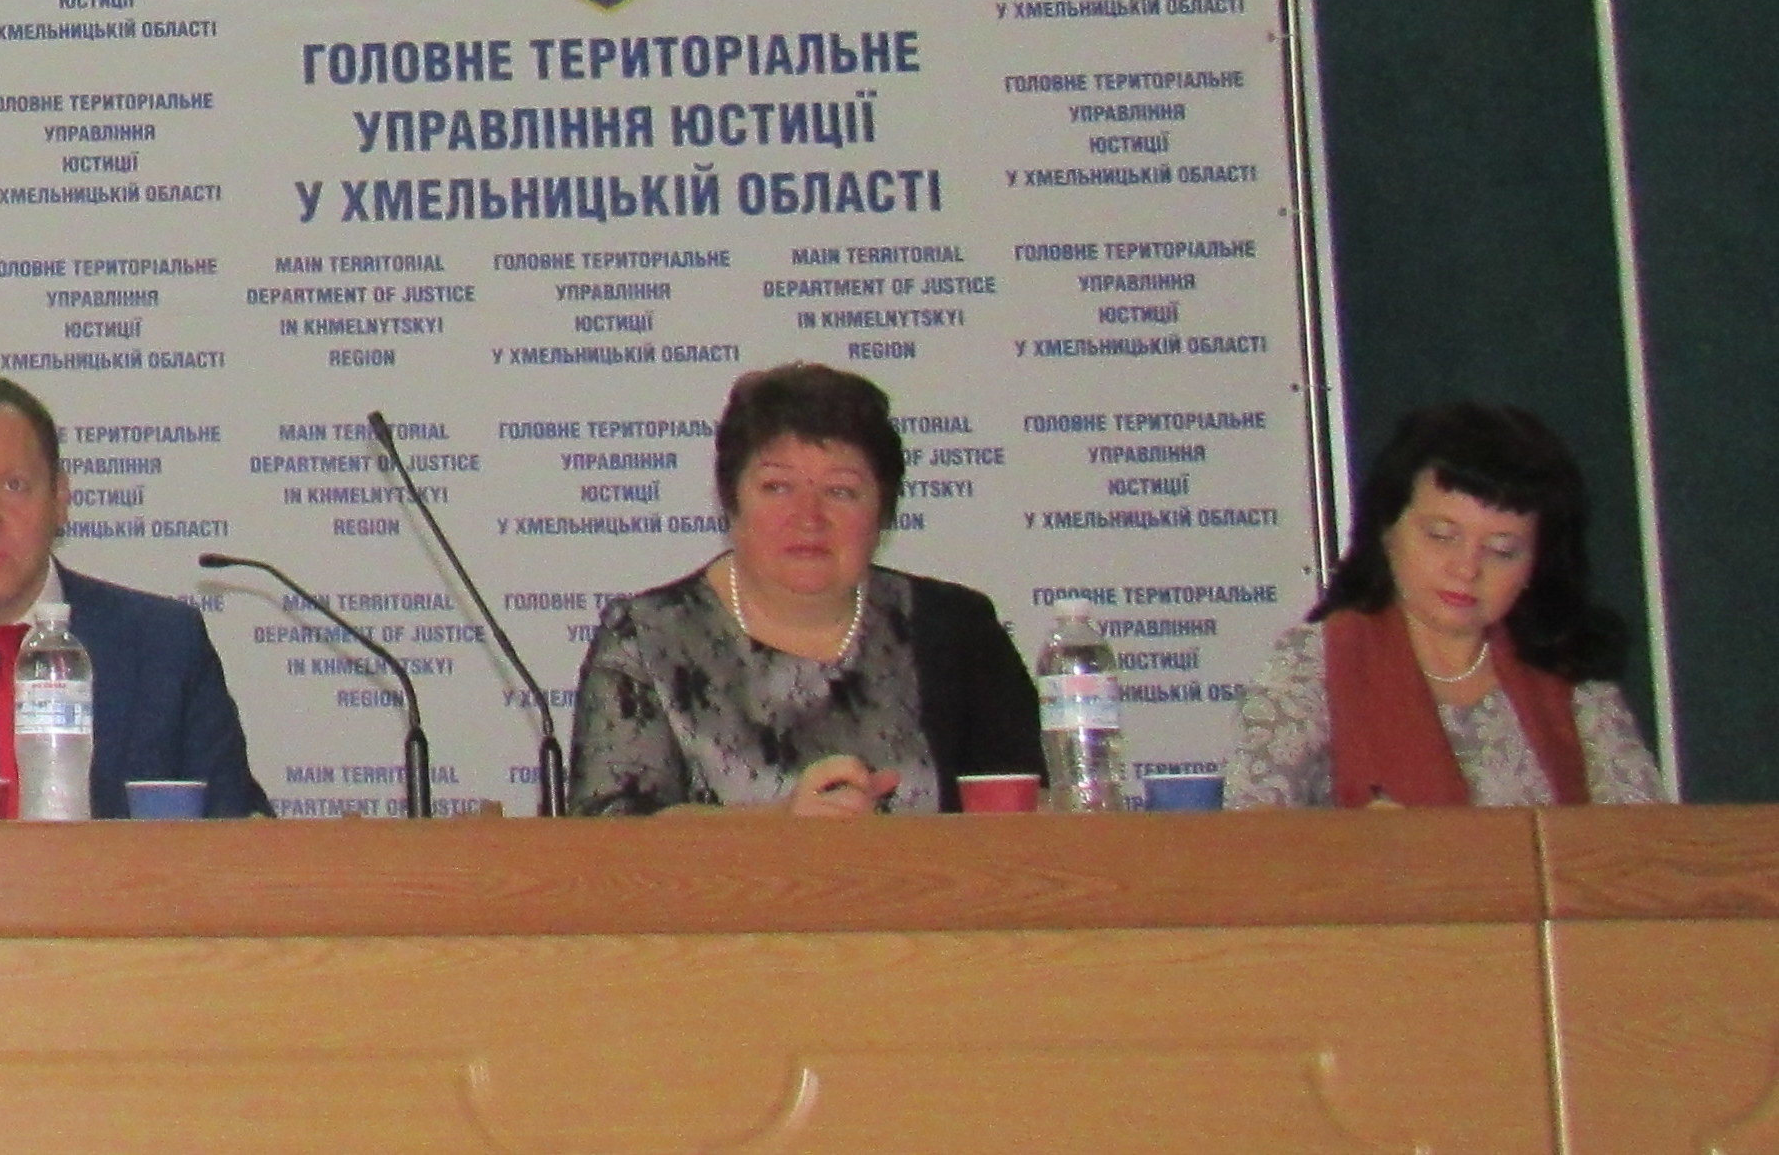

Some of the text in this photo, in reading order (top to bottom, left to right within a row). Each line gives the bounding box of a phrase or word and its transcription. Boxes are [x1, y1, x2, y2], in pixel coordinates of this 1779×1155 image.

[996, 3, 1007, 19] У
[141, 20, 217, 38] ОБЛАСТІ
[302, 30, 921, 85] ГОЛОВНЕ ТЕРИТОРІАЛЬНЕ
[1004, 71, 1245, 93] ГОЛОВНЕ ТЕРИТОРІАЛЬНЕ
[68, 92, 213, 111] ТЕРИТОРІАЛЬНЕ
[352, 90, 876, 154] УПРАВЛІННЯ ЮСТИЦІЇ
[1068, 104, 1186, 123] УПРАВЛІННЯ
[44, 124, 155, 142] УПРАВЛІННЯ
[1089, 131, 1169, 154] ЮСТИЦІЇ
[63, 150, 138, 173] ЮСТИЦІЇ
[1005, 163, 1258, 187] У ХМЕЛЬНИЦЬКІЙ ОБЛАСТІ
[144, 184, 221, 202] ОБЛАСТІ
[293, 163, 942, 224] У ХМЕЛЬНИЦЬКІЙ ОБЛАСТІ
[493, 250, 730, 271] ГОЛОВНЕ ТЕРИТОРІАЛЬНЕ
[791, 245, 965, 265] MAIN TERRITORIAL
[1014, 240, 1256, 262] ГОЛОВНЕ ТЕРИТОРІАЛЬНЕ
[73, 258, 217, 276] ТЕРИТОРІАЛЬНЕ
[275, 255, 445, 273] MAIN TERRITORIAL
[555, 283, 671, 301] УПРАВЛІННЯ
[762, 276, 997, 298] DEPARTMENT OF JUSTICE
[1078, 273, 1196, 292] УПРАВЛІННЯ
[46, 290, 159, 307] УПРАВЛІННЯ
[246, 285, 476, 305] DEPARTMENT OF JUSTICE
[797, 309, 965, 329] IN KHMELNYTSKYI
[1098, 302, 1179, 325] ЮСТИЦІЇ
[65, 316, 141, 340] ЮСТИЦІЇ
[280, 317, 443, 336] IN KHMELNYTSKYI
[574, 314, 653, 334] ЮСТИЦІЇ
[492, 345, 740, 365] У ХМЕЛЬНИЦЬКІЙ ОБЛАСТІ
[848, 341, 916, 359] REGION
[1014, 334, 1268, 357] У ХМЕЛЬНИЦЬКІЙ ОБЛАСТІ
[0, 349, 142, 371] ХМЕЛЬНИЦЬКІЙ
[147, 351, 225, 369] ОБЛАСТІ
[329, 349, 395, 367] REGION
[498, 421, 580, 440] ГОЛОВНЕ
[1023, 412, 1267, 433] ГОЛОВНЕ ТЕРИТОРІАЛЬНЕ
[74, 426, 220, 443] ТЕРИТОРІАЛЬНЕ
[278, 424, 327, 441] MAIN
[560, 452, 677, 470] УПРАВЛІННЯ
[930, 447, 1005, 466] JUSTICE
[1088, 445, 1206, 463] УПРАВЛІННЯ
[59, 457, 162, 475] ПРАВЛІННЯ
[249, 454, 481, 474] DEPARTMENT JUSTICE
[580, 480, 660, 504] ЮСТИЦІЇ
[1108, 473, 1189, 497] ЮСТИЦІЇ
[283, 488, 301, 504] IN
[333, 519, 399, 536] REGION
[496, 513, 662, 537] У ХМЕЛЬНИЦЬКІЙ
[1024, 506, 1278, 530] У ХМЕЛЬНИЦЬКІЙ ОБЛАСТІ
[151, 520, 228, 538] ОБЛАСТІ
[337, 594, 454, 611] TERRITORIAL
[504, 593, 586, 611] ГОЛОВНЕ
[1123, 585, 1278, 605] ТЕРИТОРІАЛЬНЕ
[382, 626, 486, 643] OF JUSTICE
[1098, 619, 1217, 637] УПРАВЛІННЯ
[287, 659, 305, 675] IN
[337, 690, 406, 707] REGION
[286, 767, 334, 783] MAIN
